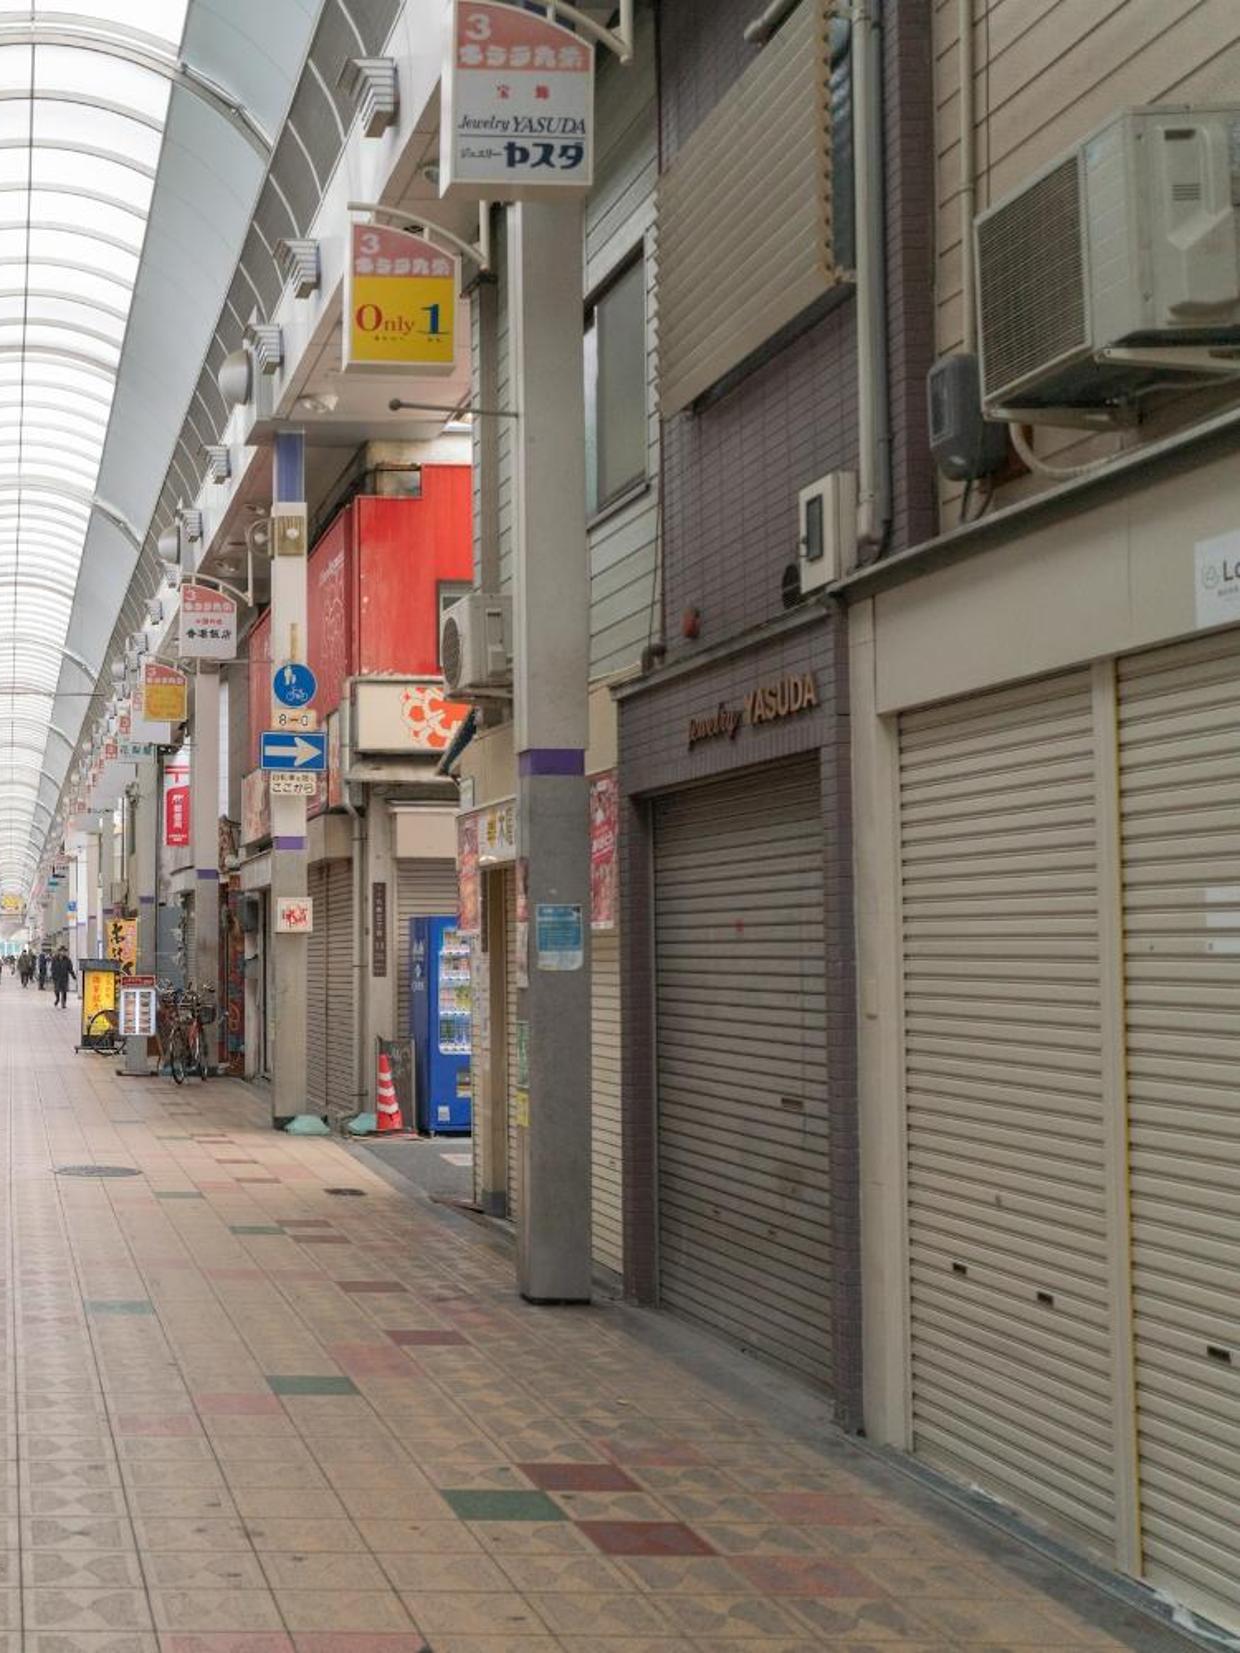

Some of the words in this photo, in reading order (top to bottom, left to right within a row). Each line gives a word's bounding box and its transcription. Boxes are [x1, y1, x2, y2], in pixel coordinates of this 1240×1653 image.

[466, 13, 491, 40] 3
[458, 114, 511, 131] Jewelry
[512, 116, 586, 135] YASUDA
[504, 141, 584, 169] ヤスダ
[361, 232, 379, 254] 3
[356, 303, 414, 336] Only
[417, 303, 449, 334] 1
[185, 590, 196, 600] 3
[744, 673, 817, 724] YASUDA
